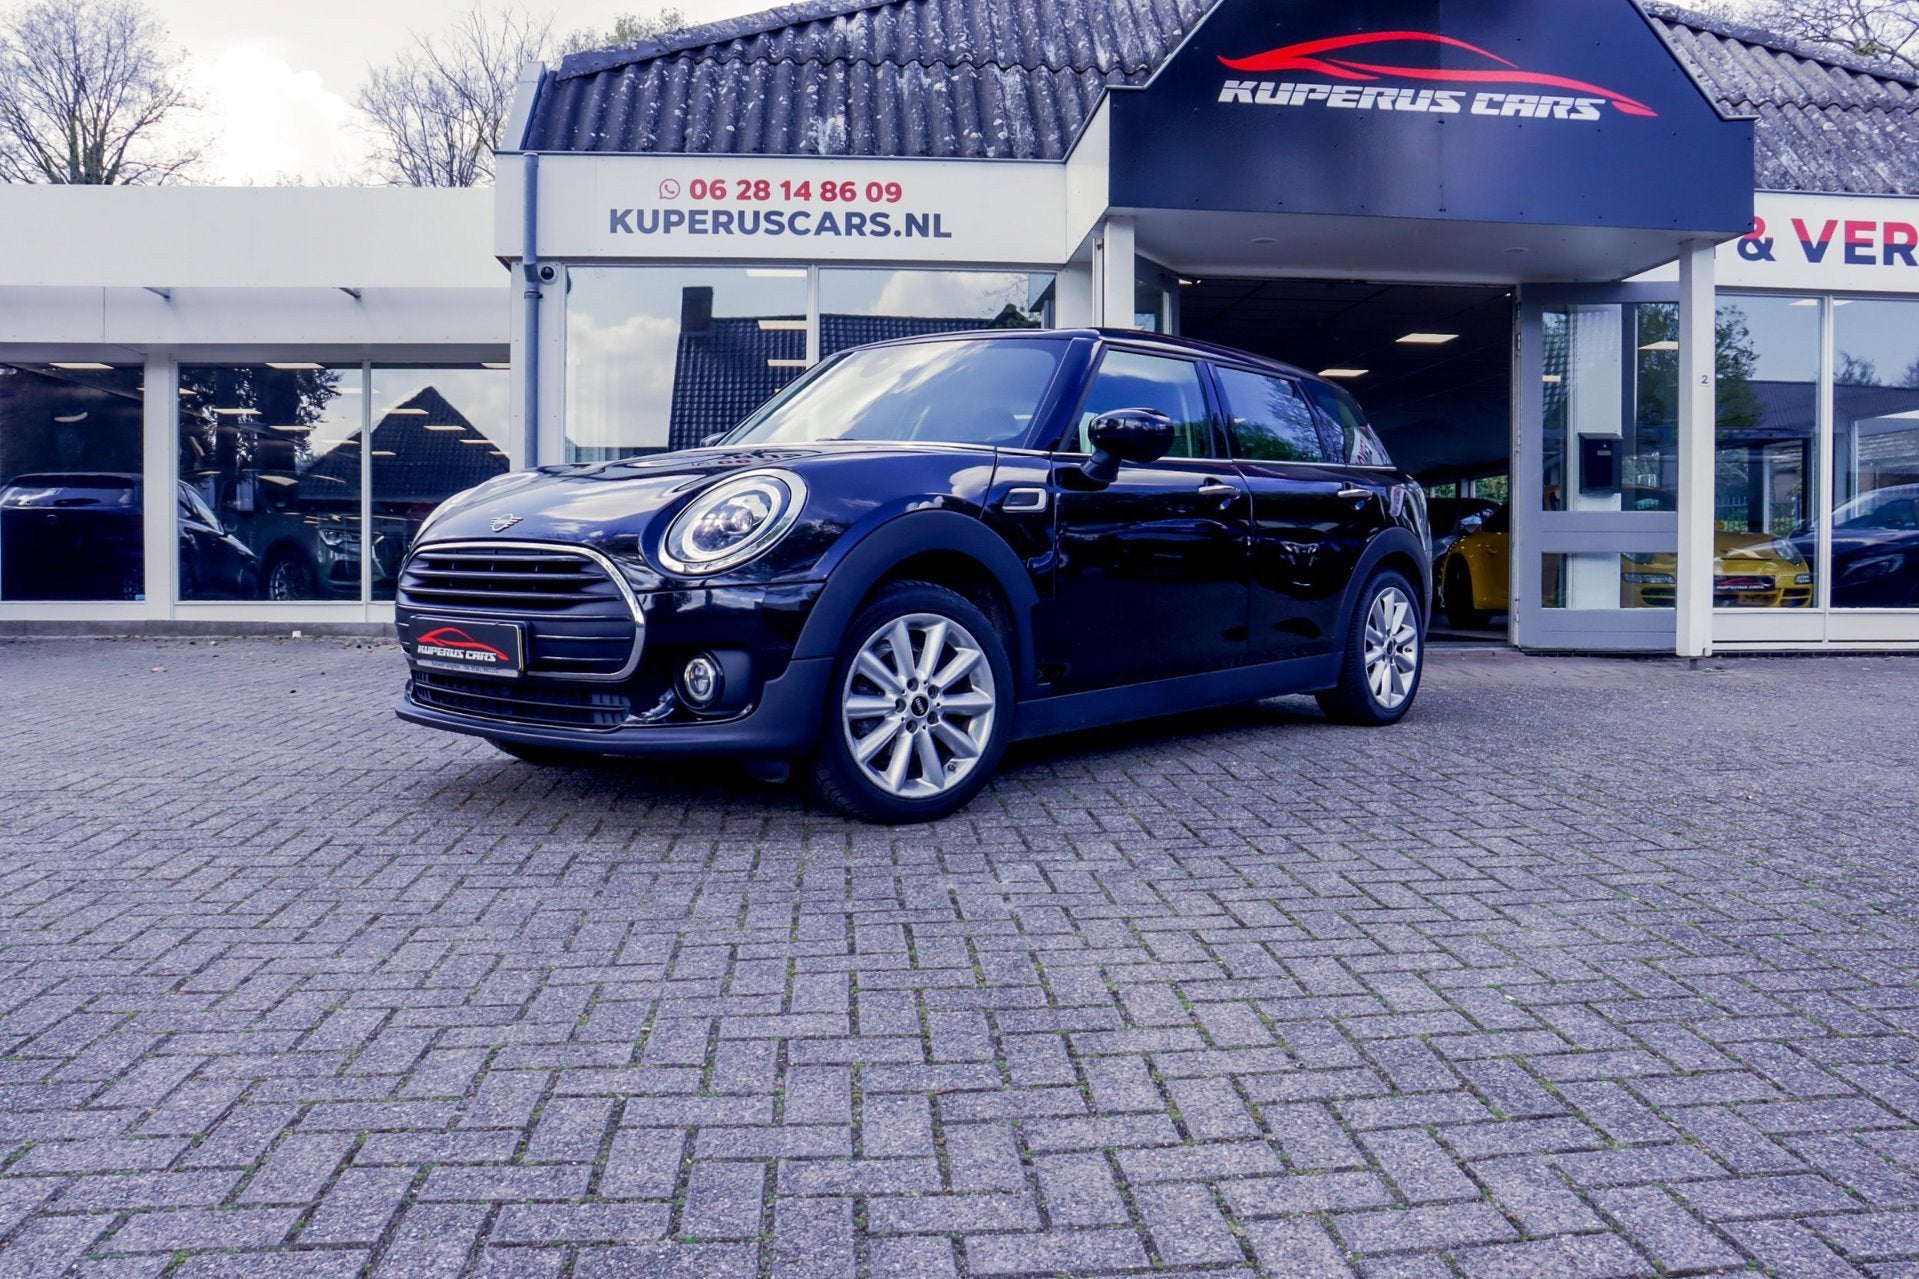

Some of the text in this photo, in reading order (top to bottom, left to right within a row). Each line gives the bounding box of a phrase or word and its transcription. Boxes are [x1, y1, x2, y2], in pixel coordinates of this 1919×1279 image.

[1217, 80, 1606, 121] KUPERUS CARS
[689, 178, 902, 203] 06 28 14 86 09
[609, 208, 952, 238] KUPERUSCARS.NL
[1737, 216, 1919, 266] & VER
[1701, 375, 1709, 384] 2
[417, 645, 497, 662] KUPERUS CARS
